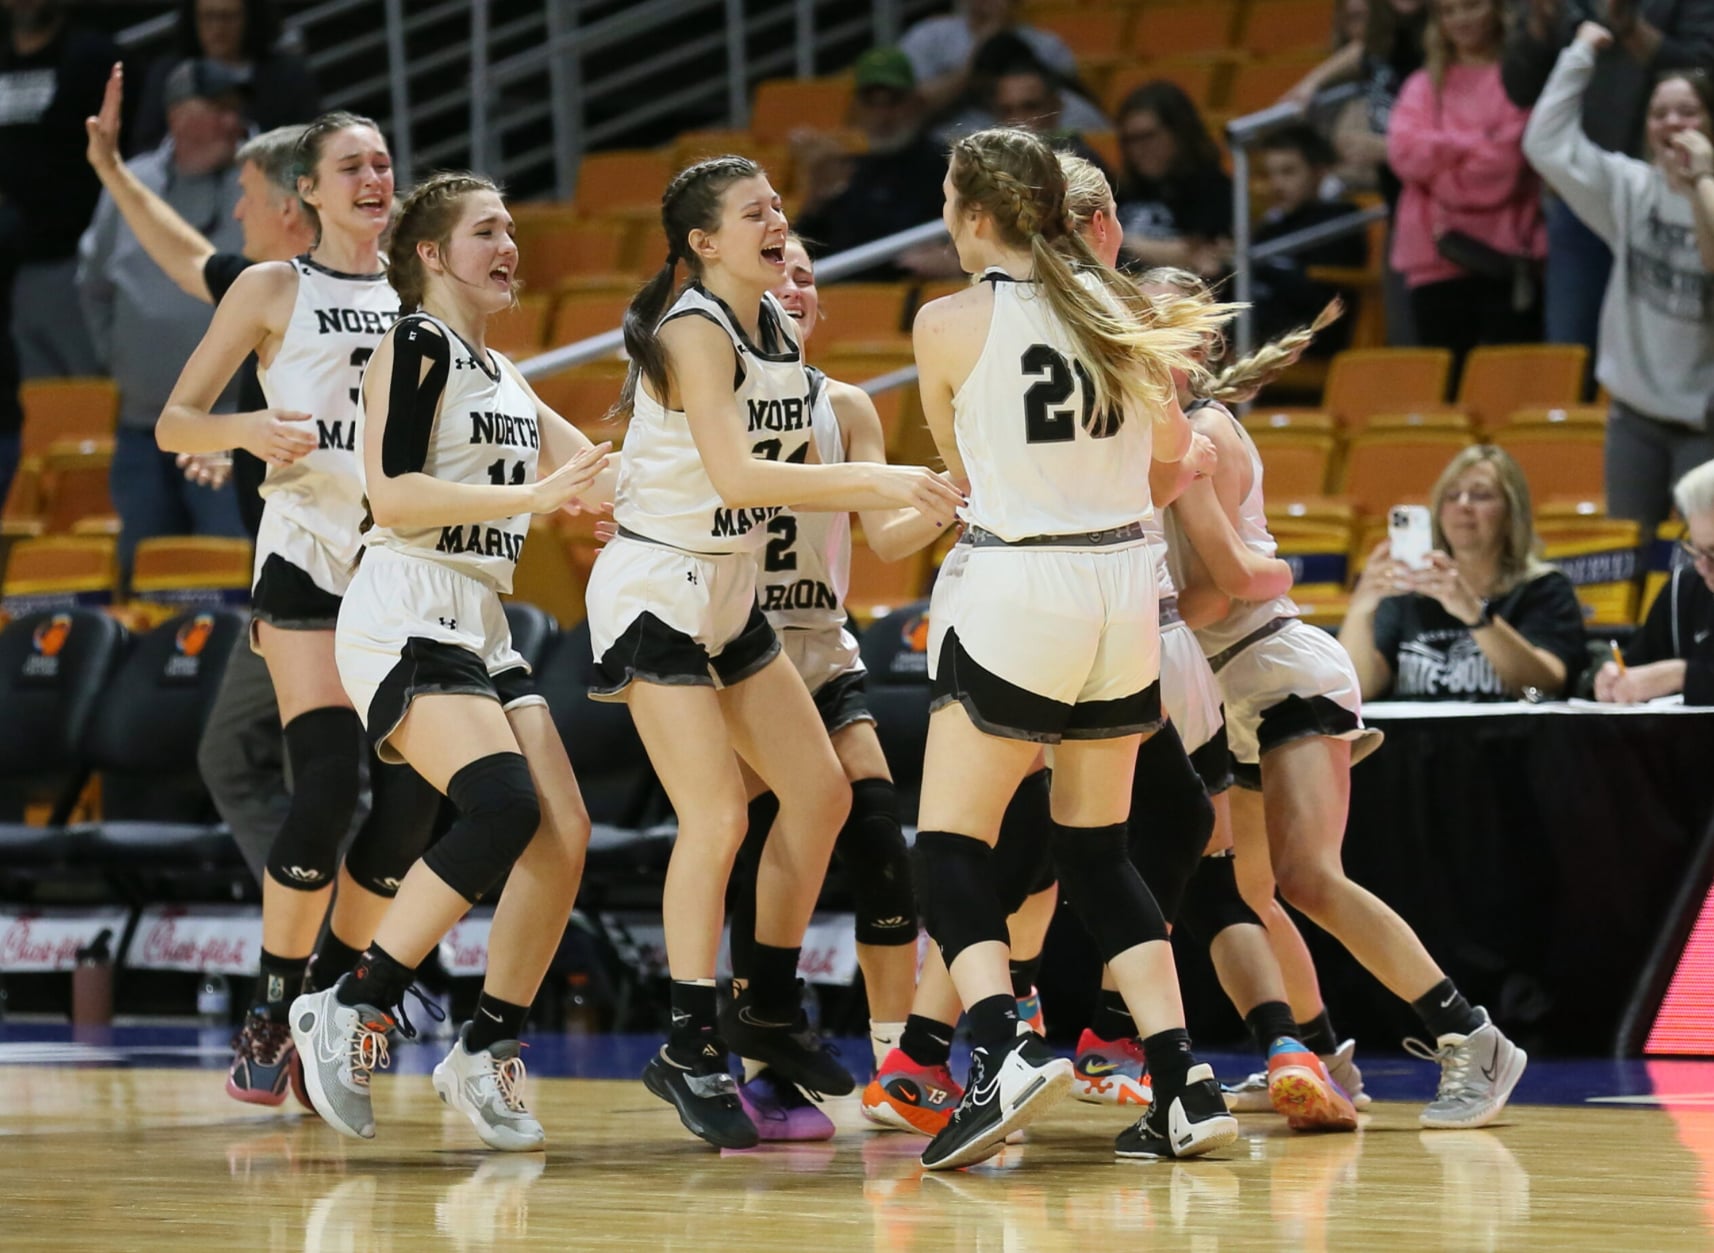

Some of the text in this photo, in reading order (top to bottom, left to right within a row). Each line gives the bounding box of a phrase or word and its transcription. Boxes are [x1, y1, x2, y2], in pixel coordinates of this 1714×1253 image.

[314, 308, 400, 334] NORT
[469, 411, 539, 451] NORTH
[748, 398, 813, 432] NORT
[436, 525, 525, 564] MARIO
[764, 515, 798, 572] 2
[760, 579, 838, 612] RION
[927, 1088, 948, 1105] 13
